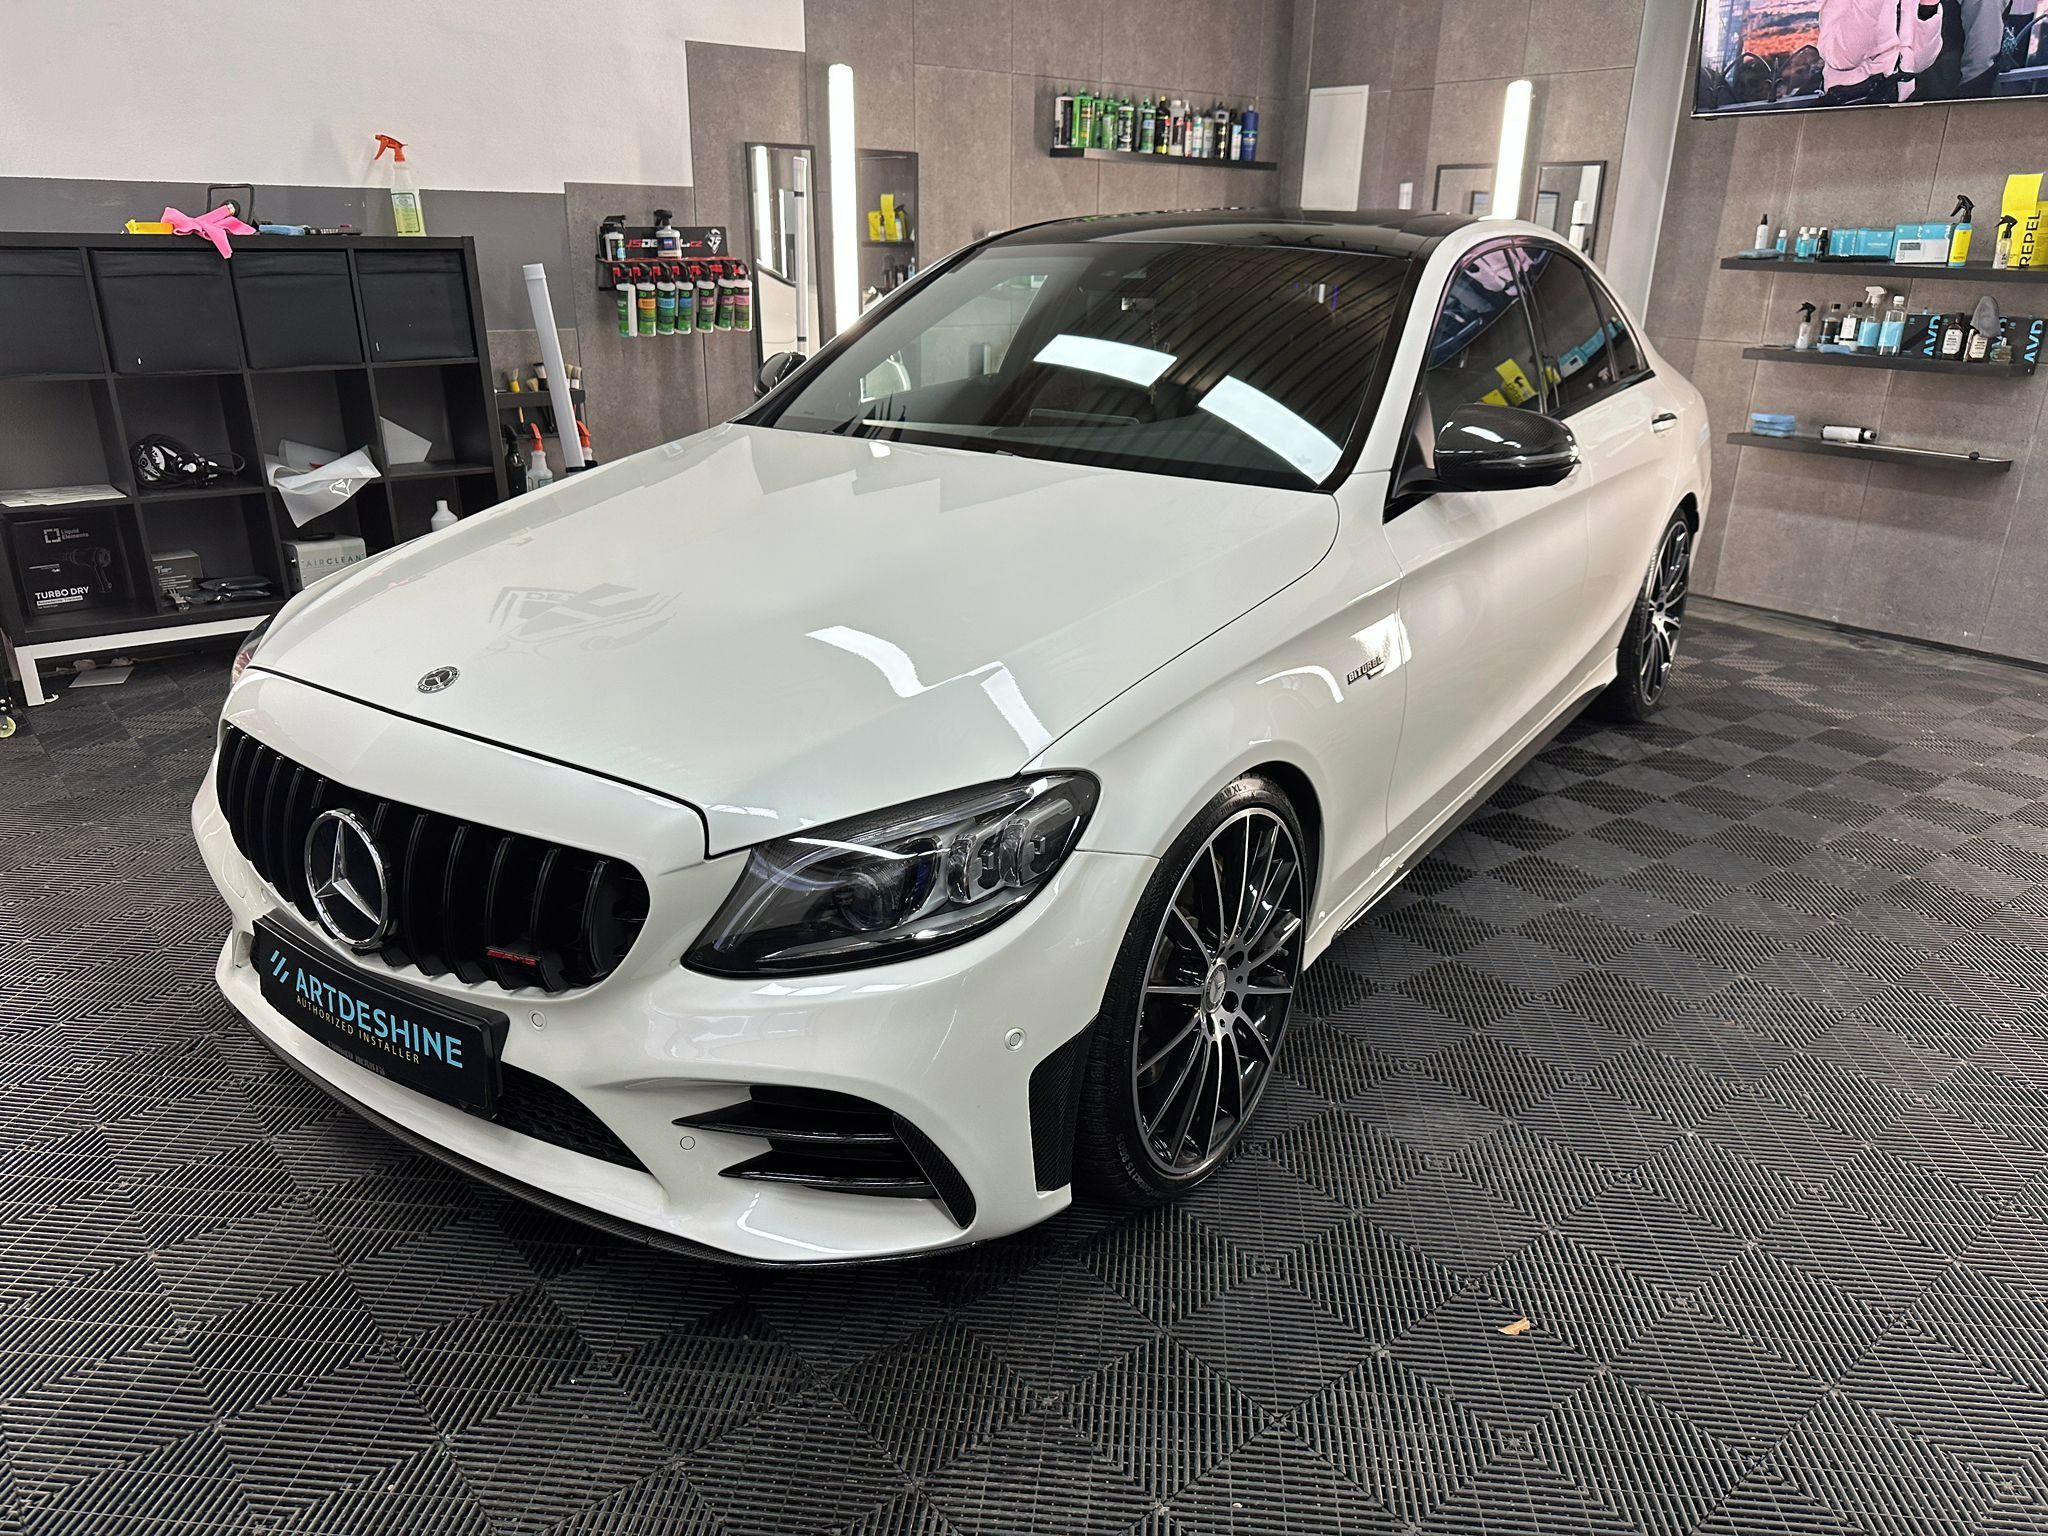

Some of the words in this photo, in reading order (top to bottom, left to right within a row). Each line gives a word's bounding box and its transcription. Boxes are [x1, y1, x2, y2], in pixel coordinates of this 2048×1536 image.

[2019, 210, 2041, 268] REPEL
[35, 588, 69, 600] TURBO
[70, 585, 89, 596] DRY
[296, 967, 463, 1069] ARTDESHINE
[296, 994, 354, 1036] AUTHORIZED
[358, 1029, 420, 1065] INSTALLER
